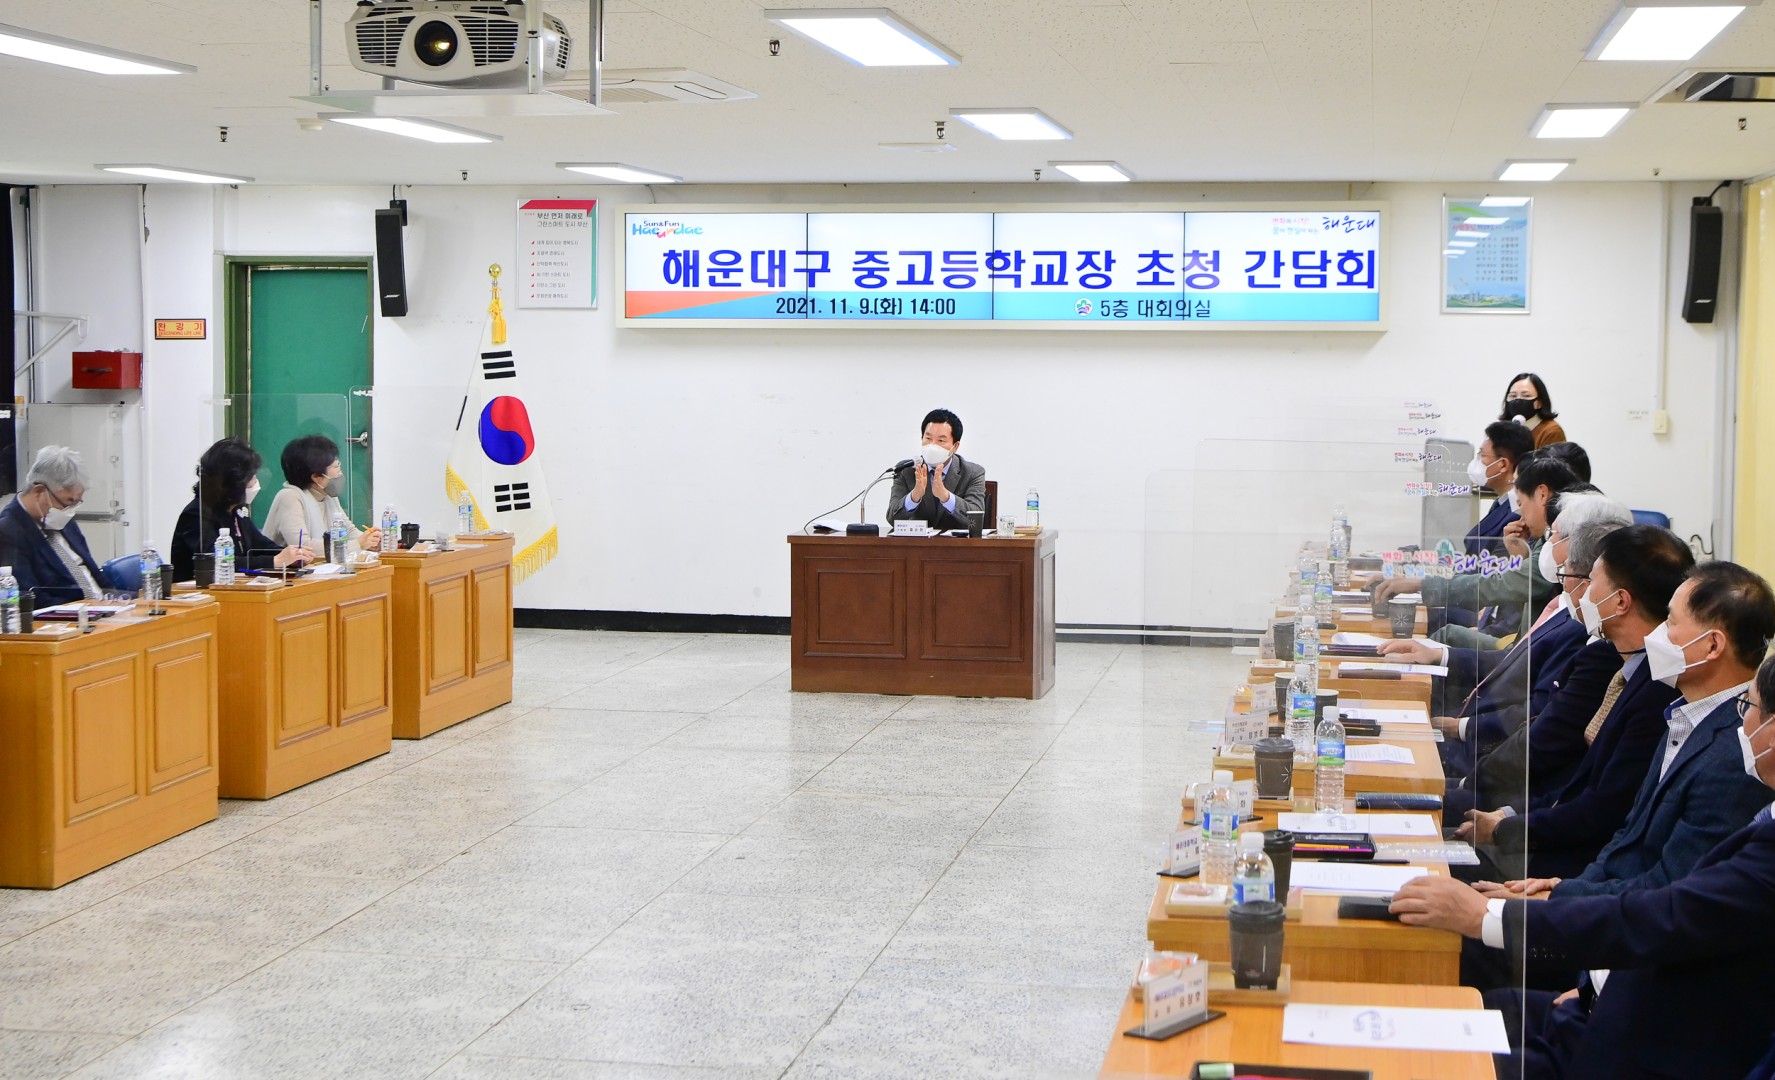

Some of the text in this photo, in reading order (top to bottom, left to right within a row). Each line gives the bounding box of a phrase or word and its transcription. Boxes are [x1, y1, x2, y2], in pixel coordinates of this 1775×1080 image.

[537, 212, 549, 220] 부산
[551, 212, 563, 220] 먼저
[565, 212, 583, 220] 미래로
[1322, 215, 1375, 233] 해운대
[632, 223, 703, 239] Haeundae
[663, 249, 1375, 290] 해운대구 중고등학교장 초청 간담회
[776, 298, 823, 315] 2021.
[829, 298, 853, 315] 11.
[910, 298, 956, 315] 14:00
[1101, 299, 1212, 318] 5층 대회의실
[1418, 452, 1442, 462] 해운대
[1438, 482, 1469, 496] 해운대
[1454, 550, 1522, 576] 해운대
